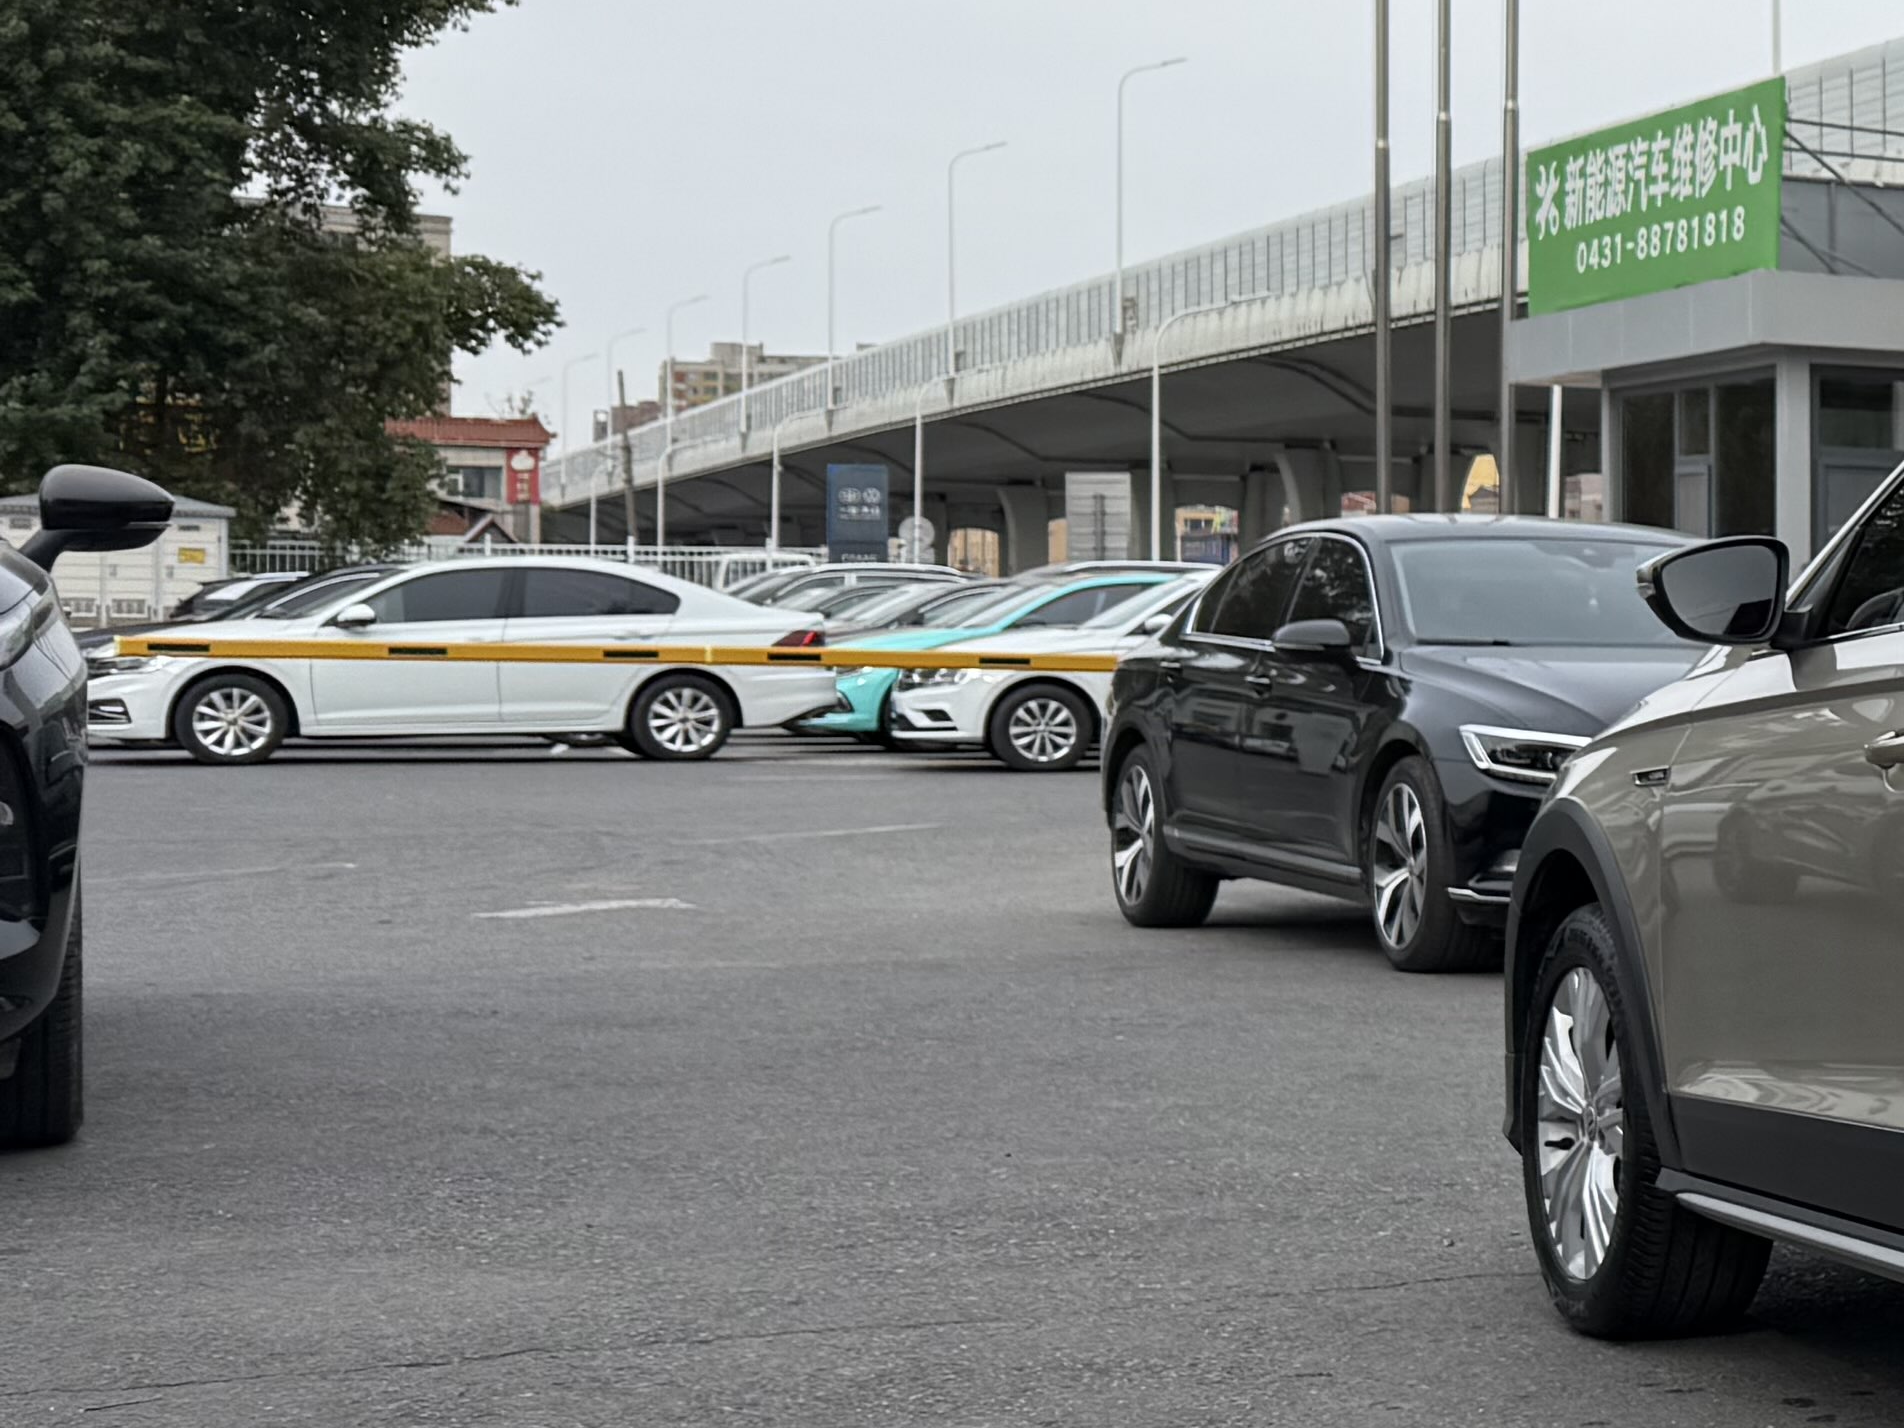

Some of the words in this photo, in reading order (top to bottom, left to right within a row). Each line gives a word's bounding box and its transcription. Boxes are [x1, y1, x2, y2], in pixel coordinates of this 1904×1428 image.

[1563, 103, 1769, 230] 新能源汽车维修中心
[1576, 205, 1746, 274] 0431-88781818
